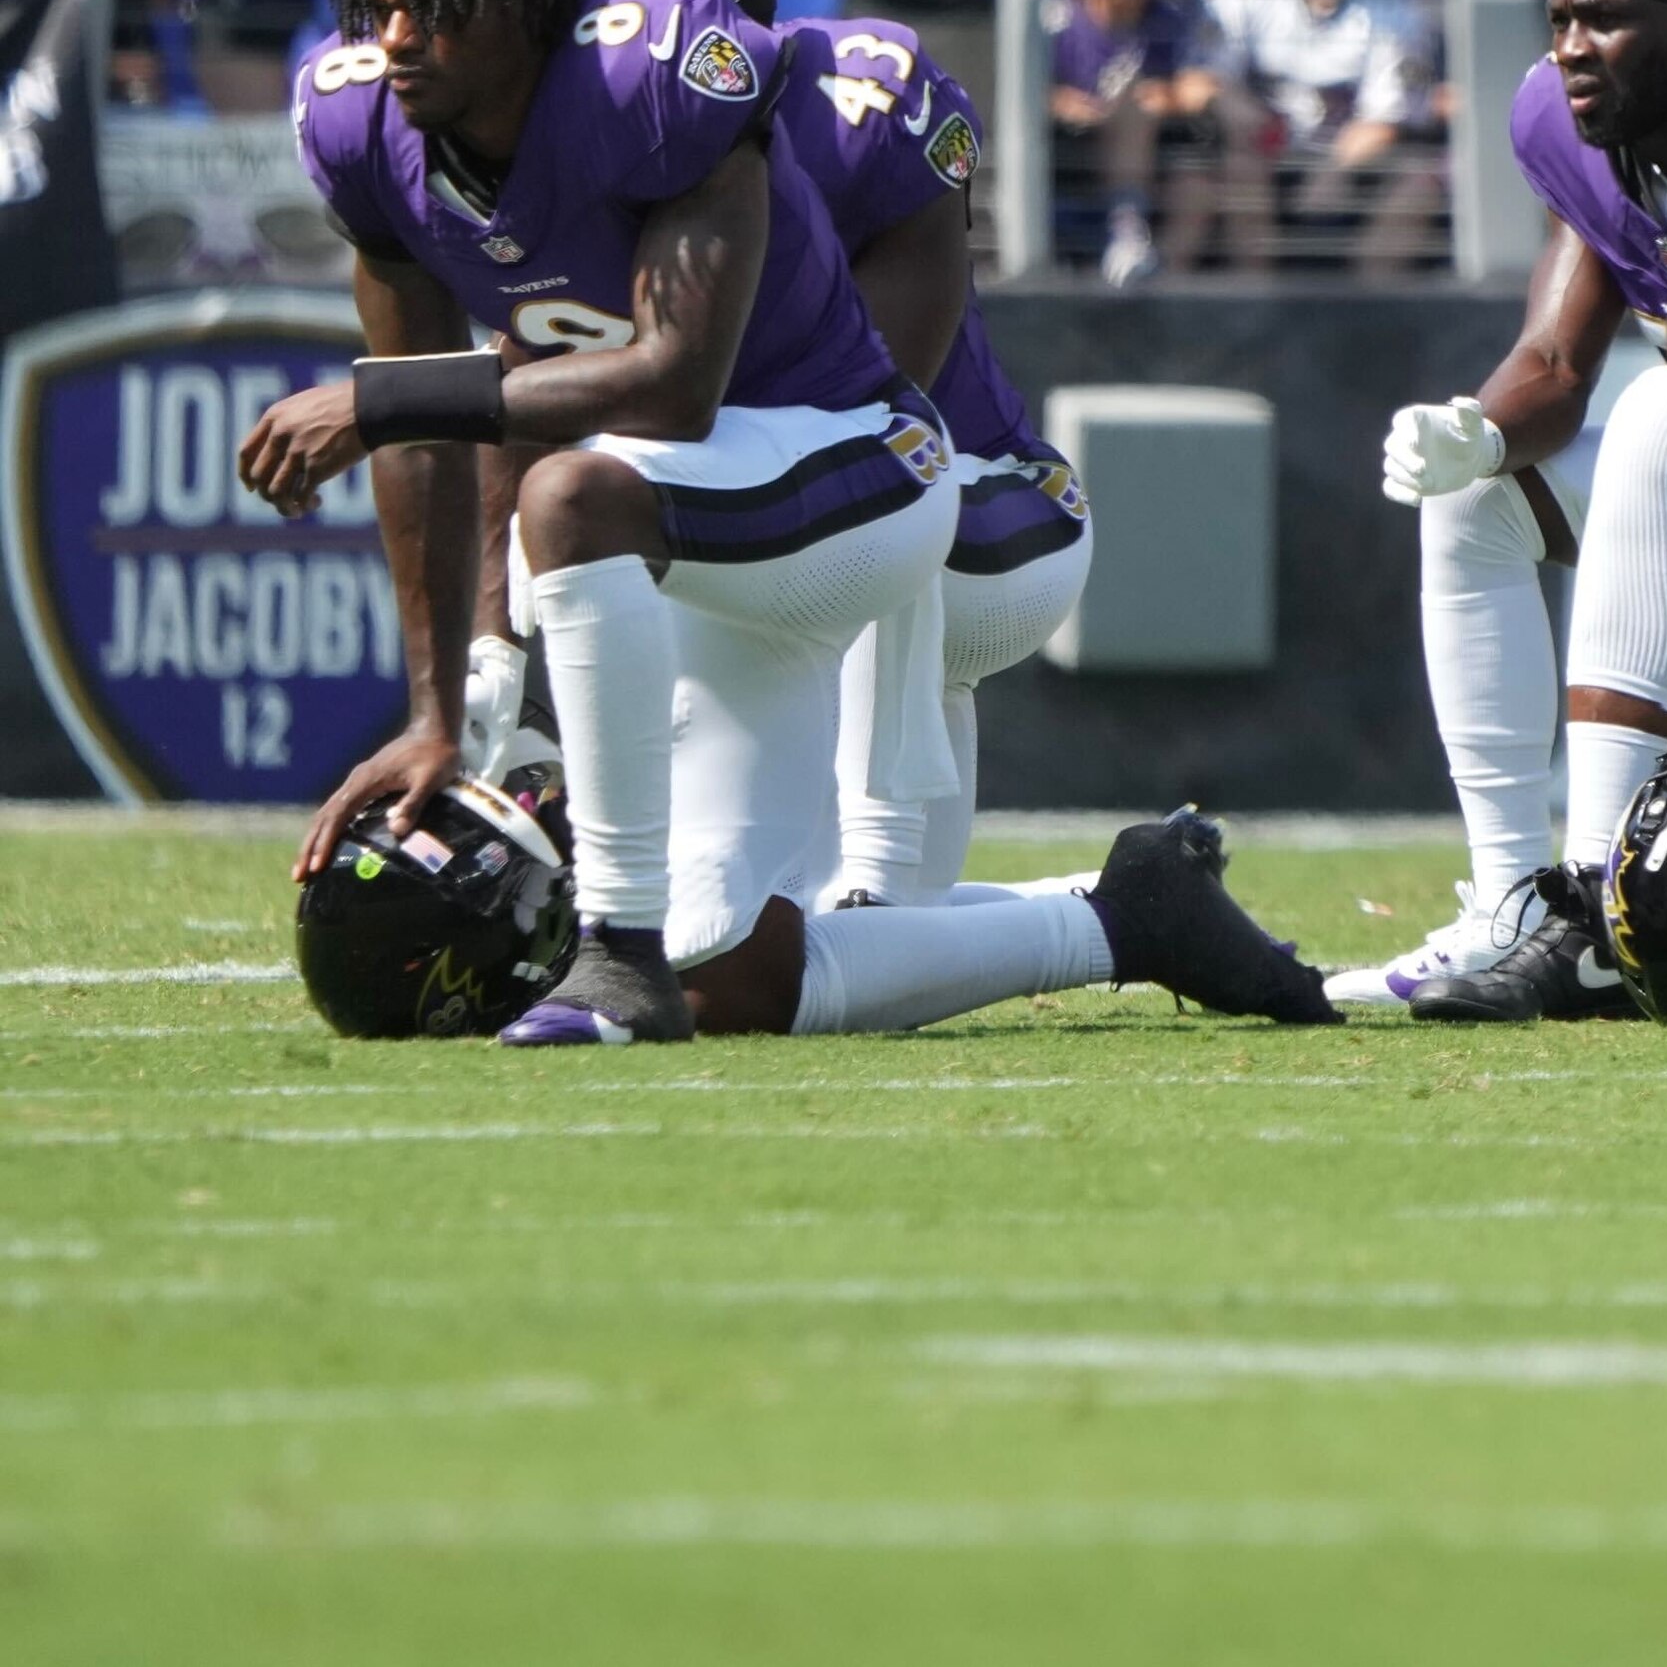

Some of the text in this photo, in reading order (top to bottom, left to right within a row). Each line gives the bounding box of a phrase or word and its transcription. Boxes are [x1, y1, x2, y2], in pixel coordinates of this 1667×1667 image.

[574, 1, 647, 48] 8
[313, 42, 390, 96] 8
[816, 32, 916, 128] 43
[497, 276, 570, 294] RAVENS
[222, 681, 291, 769] 12
